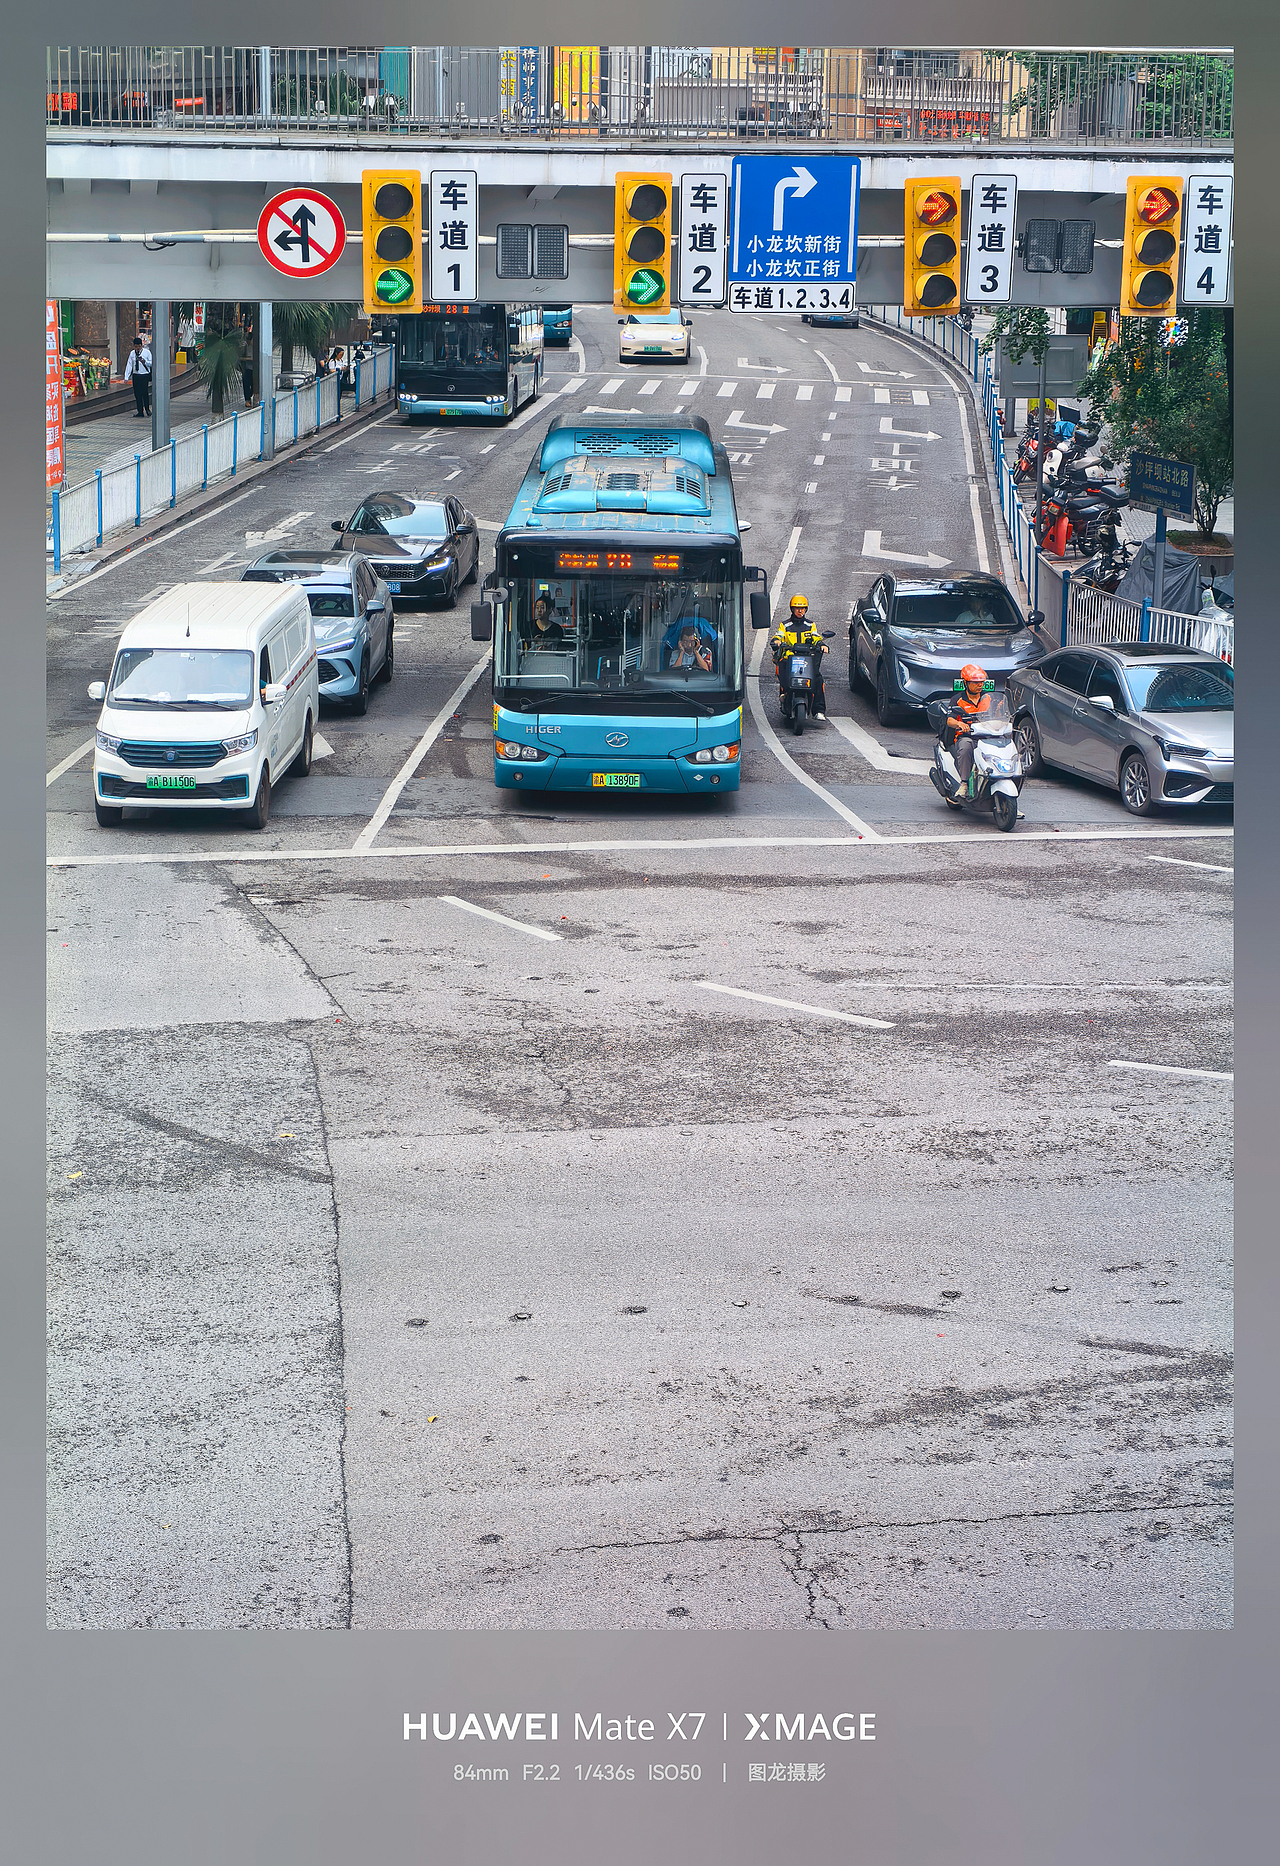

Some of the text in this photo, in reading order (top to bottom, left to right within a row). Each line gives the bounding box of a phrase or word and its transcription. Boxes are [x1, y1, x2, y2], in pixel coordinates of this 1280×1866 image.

[439, 179, 470, 292] 车道1
[688, 183, 718, 294] 车道2
[746, 234, 842, 254] 小龙坎新街
[977, 183, 1008, 293] 车道3
[1193, 184, 1224, 295] 车道4
[746, 258, 842, 278] 小龙坎正街
[446, 304, 457, 315] 28
[1135, 459, 1189, 487] 沙坪坝站北路
[525, 725, 562, 734] HIGER
